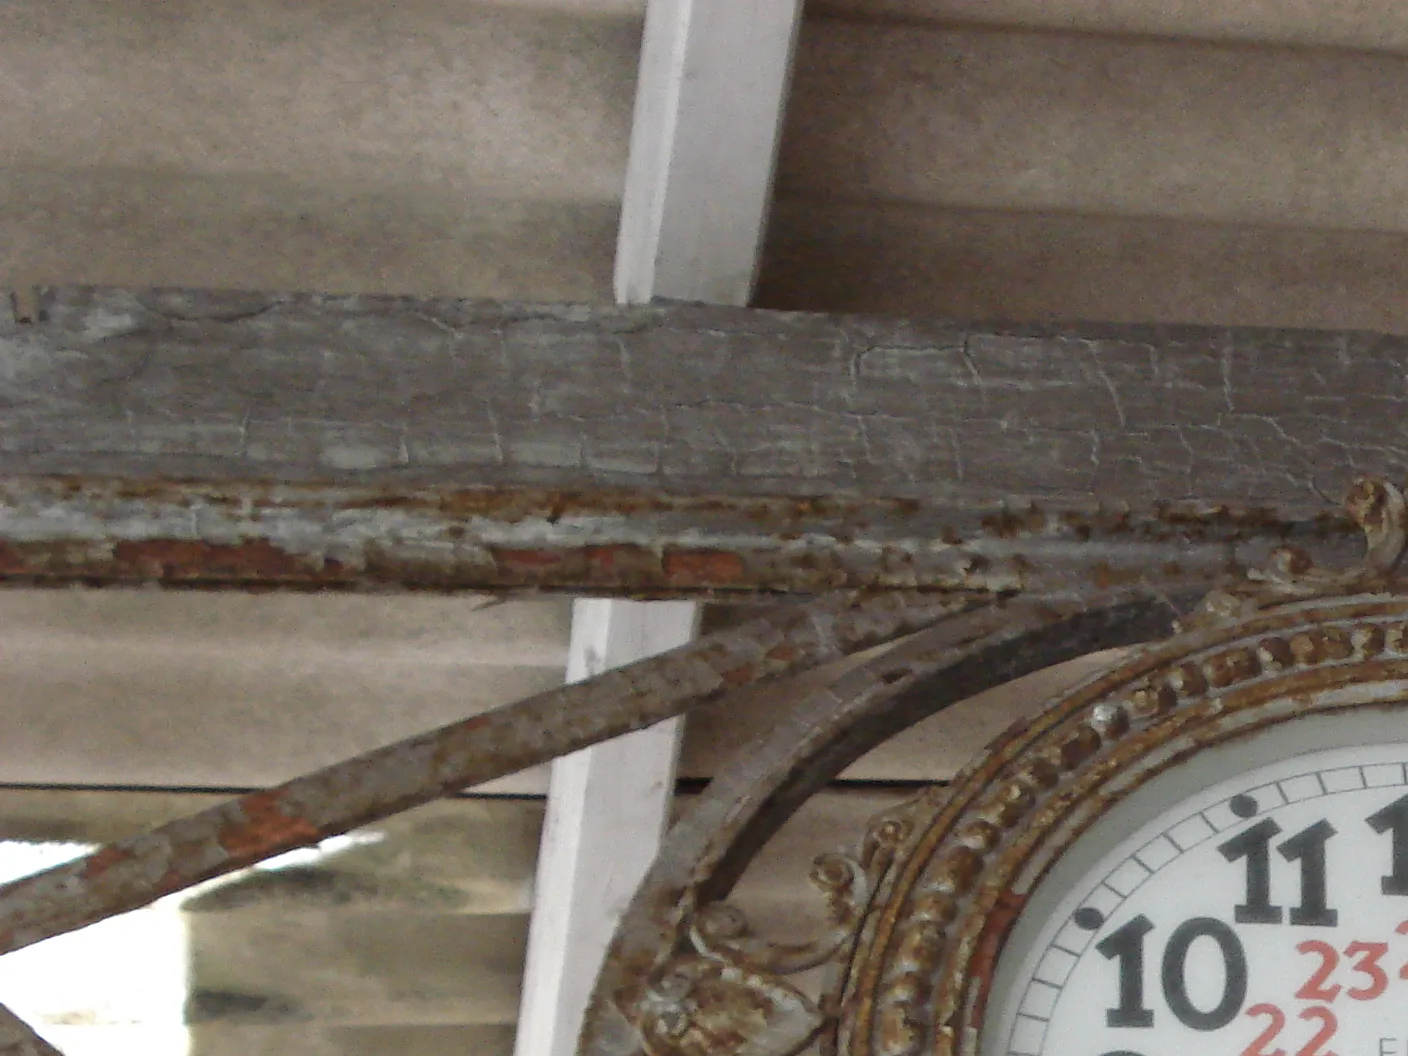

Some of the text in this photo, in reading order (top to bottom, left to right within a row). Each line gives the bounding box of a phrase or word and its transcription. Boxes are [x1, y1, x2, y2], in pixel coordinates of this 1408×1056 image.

[1217, 816, 1338, 927] 11
[1095, 914, 1248, 1032] 10
[1295, 940, 1389, 1002] 23
